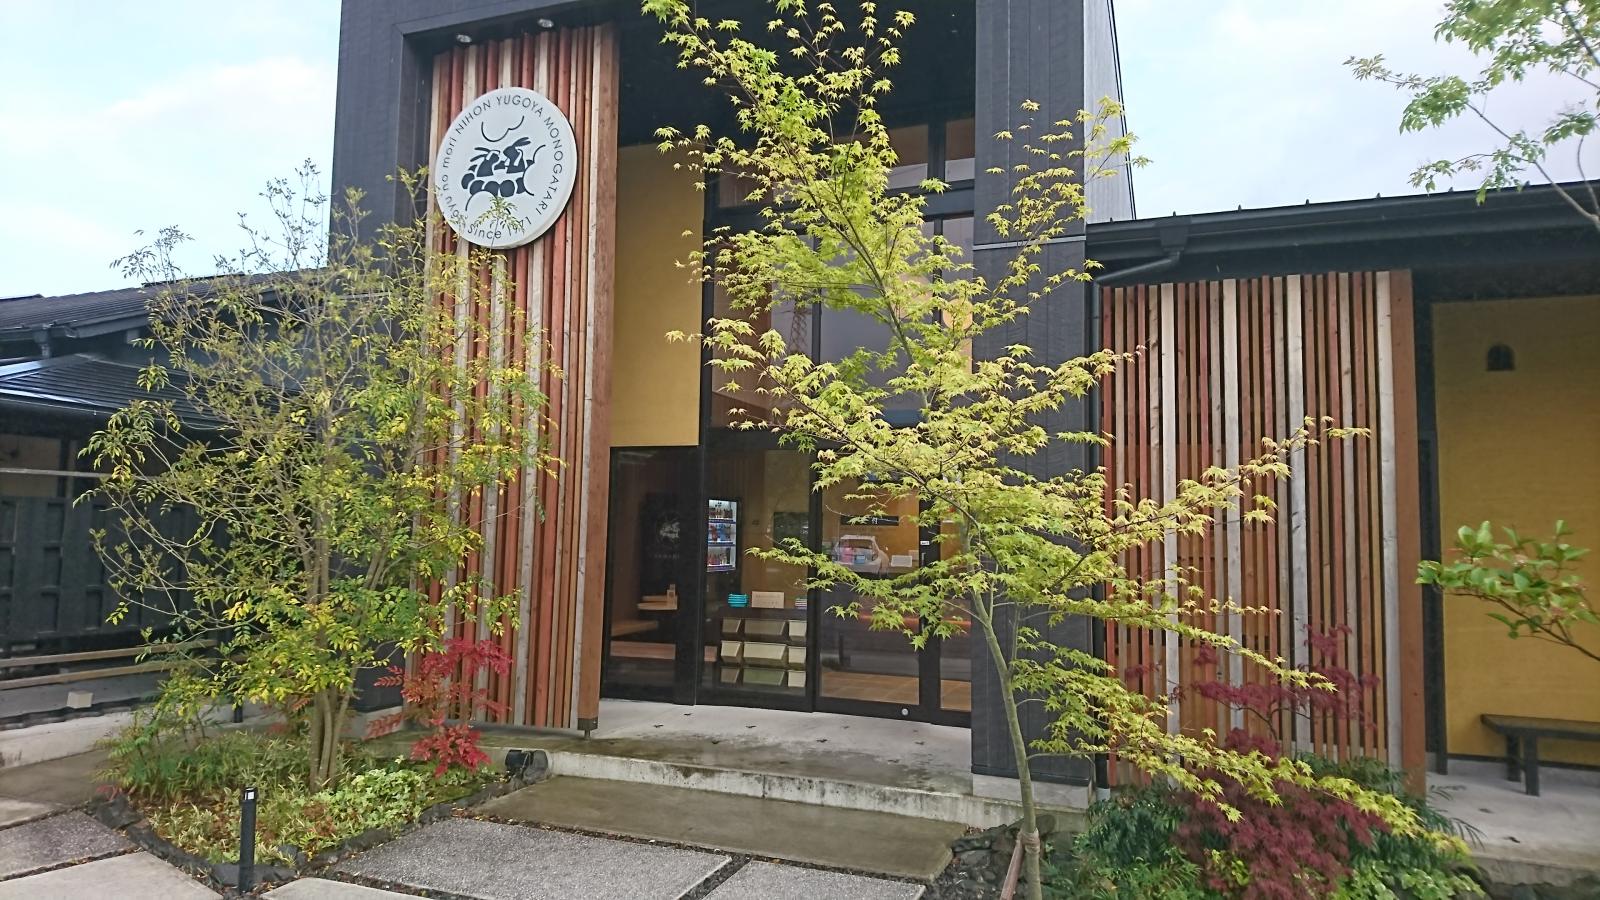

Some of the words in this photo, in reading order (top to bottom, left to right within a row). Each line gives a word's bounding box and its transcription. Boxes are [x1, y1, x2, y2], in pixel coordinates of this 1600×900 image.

[455, 100, 491, 135] NIHON
[496, 94, 544, 118] YUGOYA
[442, 136, 457, 168] mori
[535, 116, 564, 215] MONOGATARI
[441, 174, 449, 191] no
